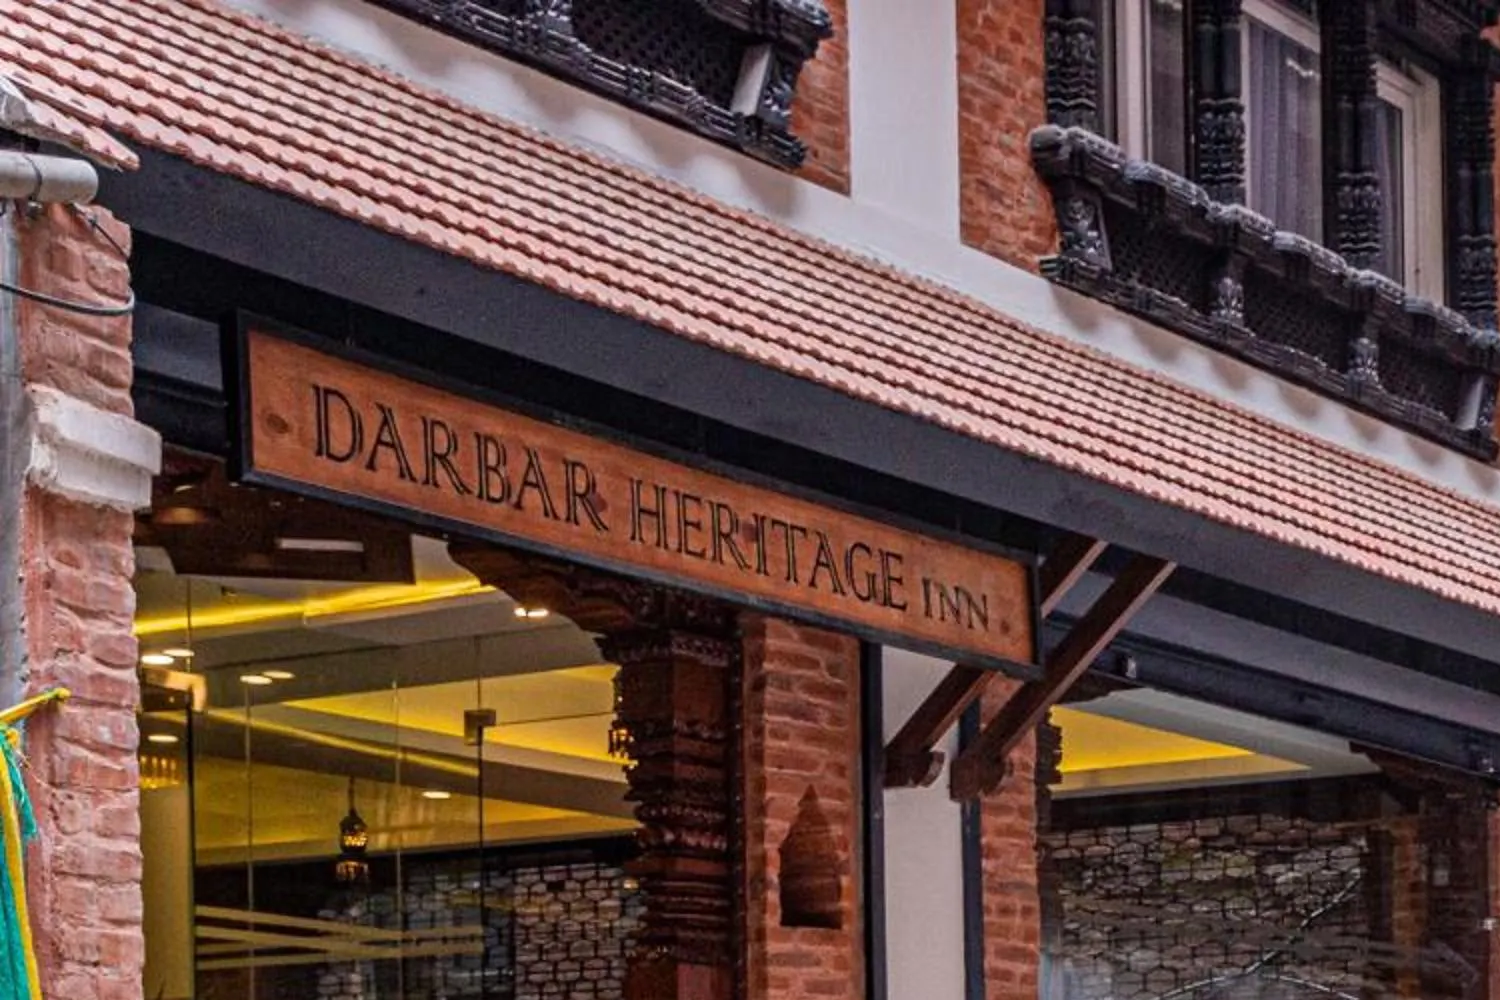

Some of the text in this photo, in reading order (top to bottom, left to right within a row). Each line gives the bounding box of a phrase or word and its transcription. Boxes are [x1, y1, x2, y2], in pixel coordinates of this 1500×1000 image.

[312, 384, 990, 632] DARBAR HERITAGE INN
